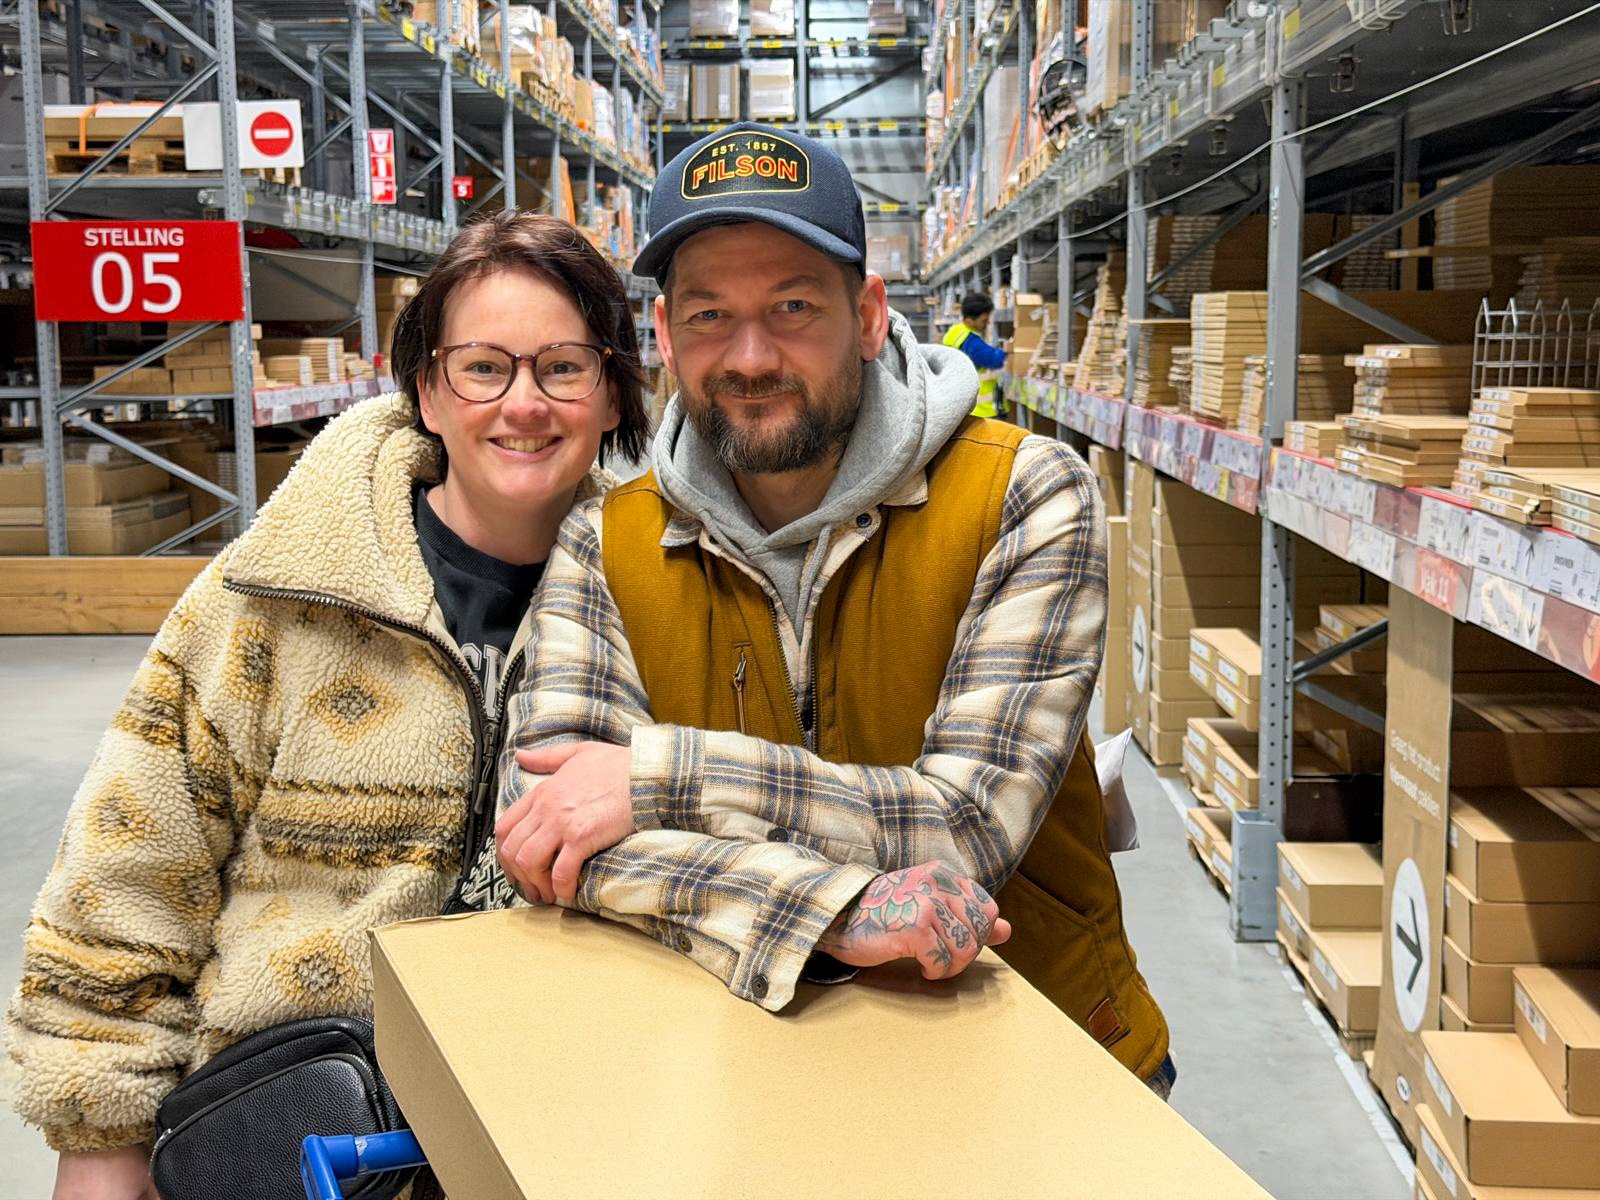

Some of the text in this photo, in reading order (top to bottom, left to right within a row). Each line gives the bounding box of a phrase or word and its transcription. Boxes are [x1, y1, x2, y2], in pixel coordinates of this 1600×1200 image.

[712, 142, 776, 157] EST. 1897
[692, 154, 798, 190] FILSON
[84, 227, 185, 247] STELLING
[91, 250, 182, 314] 05
